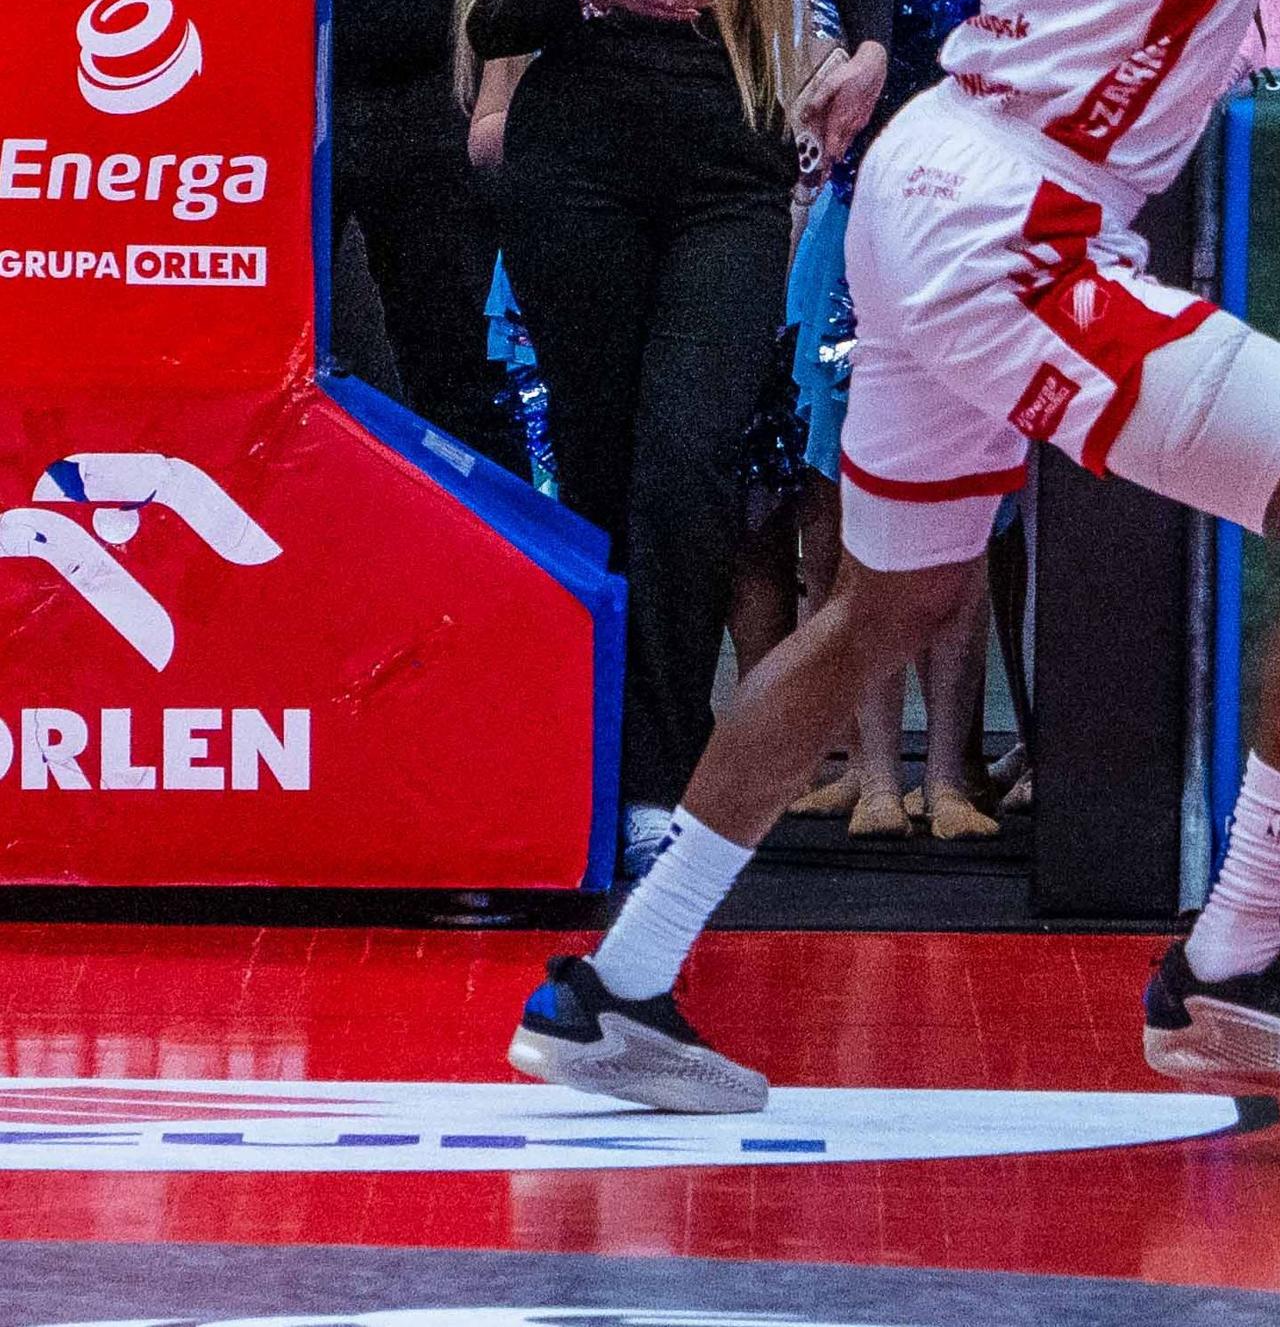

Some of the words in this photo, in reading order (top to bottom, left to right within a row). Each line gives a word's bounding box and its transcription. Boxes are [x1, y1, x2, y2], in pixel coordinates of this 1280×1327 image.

[0, 138, 267, 221] Energa
[0, 250, 120, 279] GRUPA
[134, 251, 257, 280] ORLEN
[0, 708, 310, 790] RLEN
